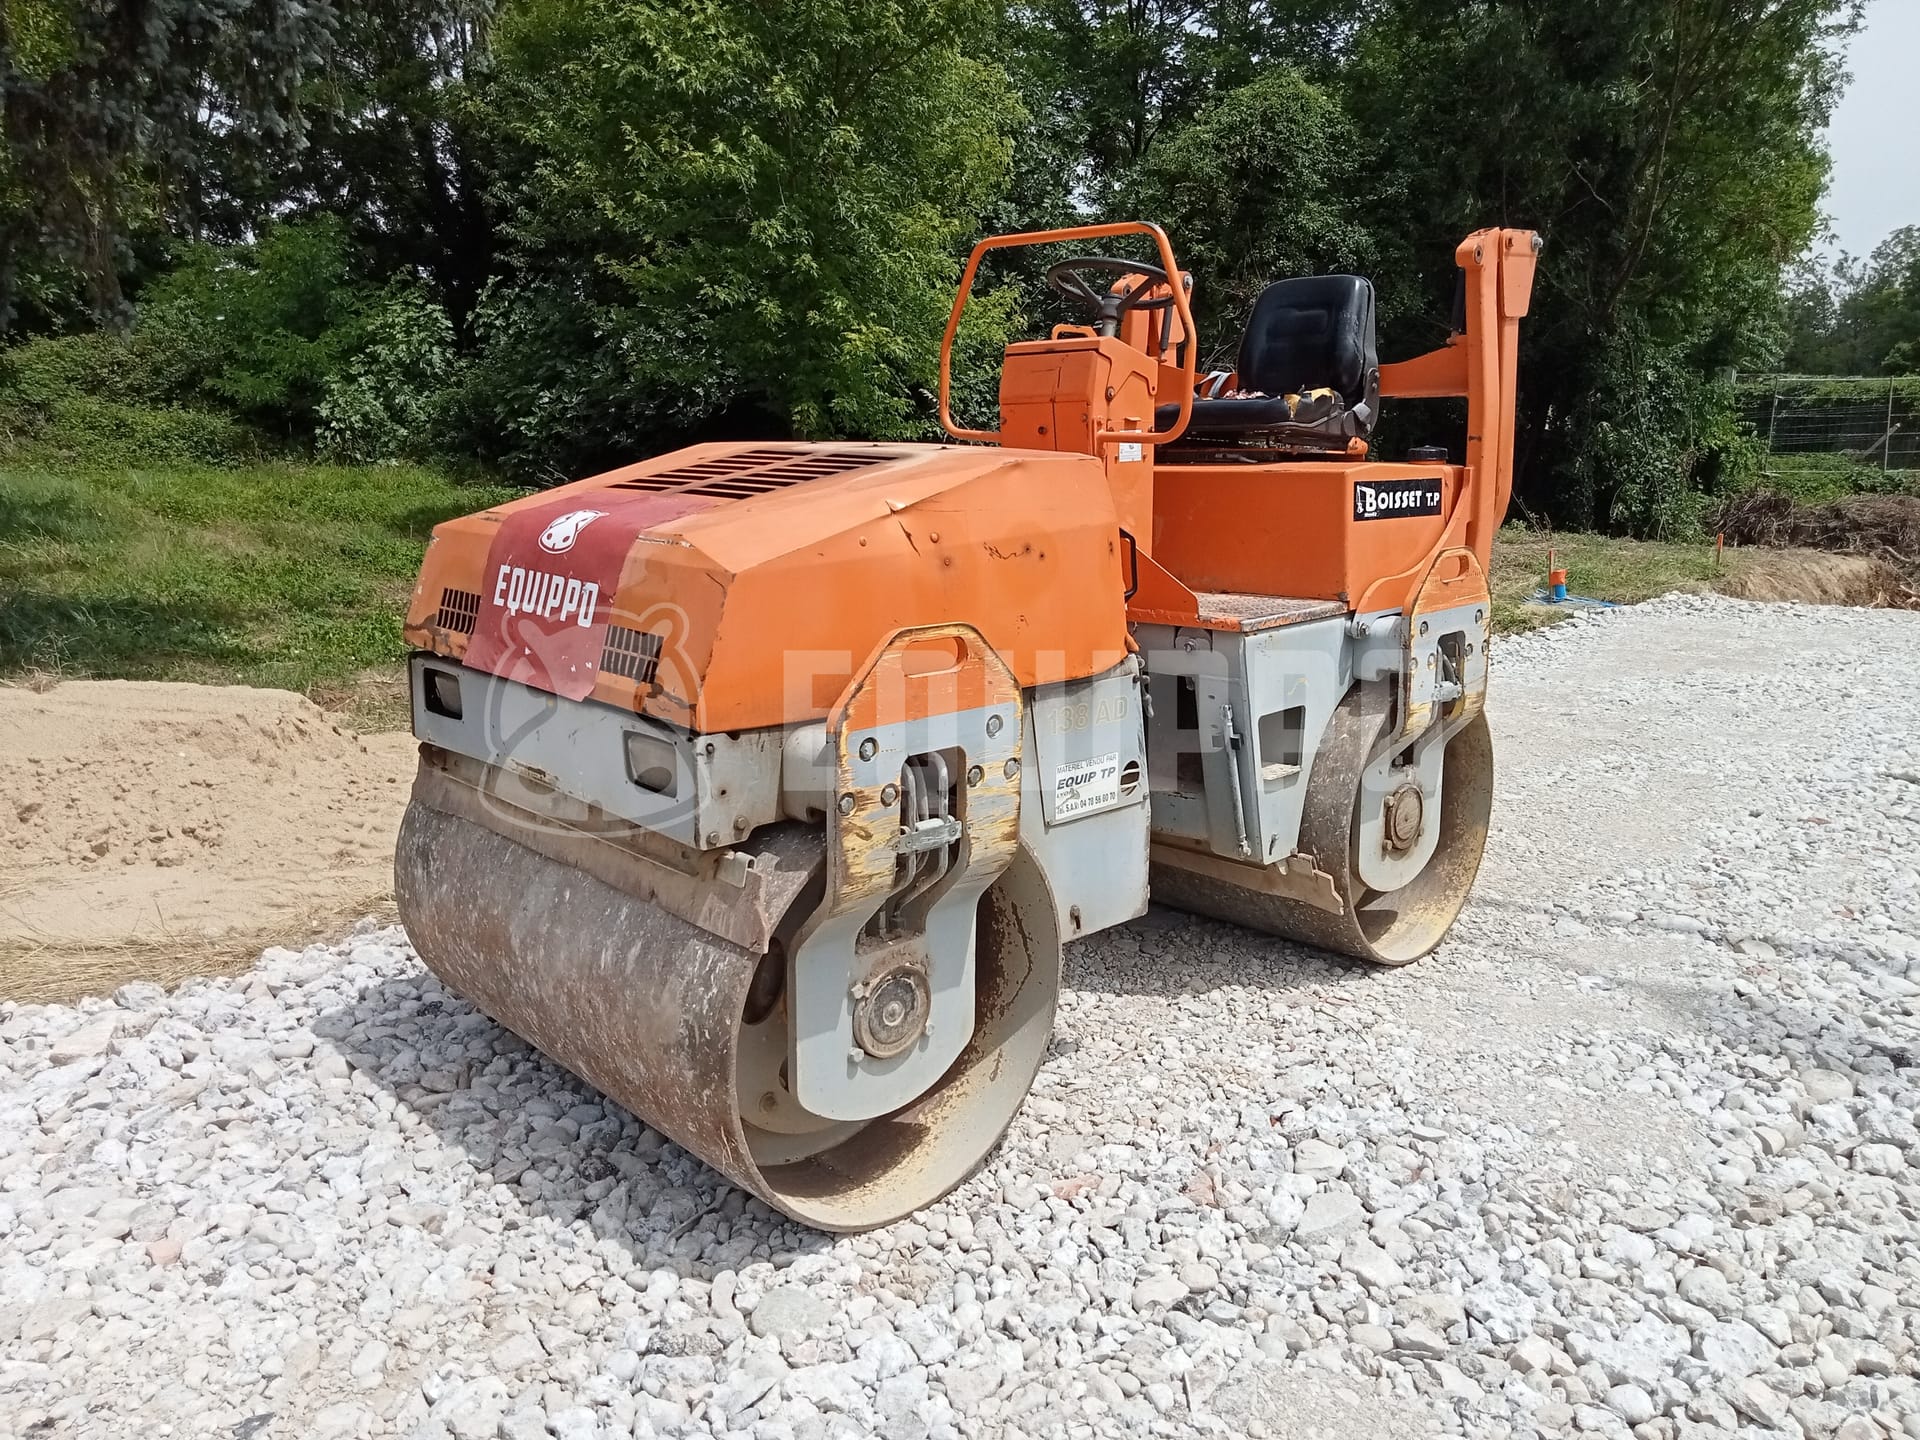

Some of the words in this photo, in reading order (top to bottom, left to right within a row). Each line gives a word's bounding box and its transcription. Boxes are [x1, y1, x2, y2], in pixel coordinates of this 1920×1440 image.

[493, 564, 599, 628] EQUIPPO
[1096, 696, 1129, 726] AD
[1057, 771, 1097, 790] EQUIP
[1101, 766, 1116, 779] TP
